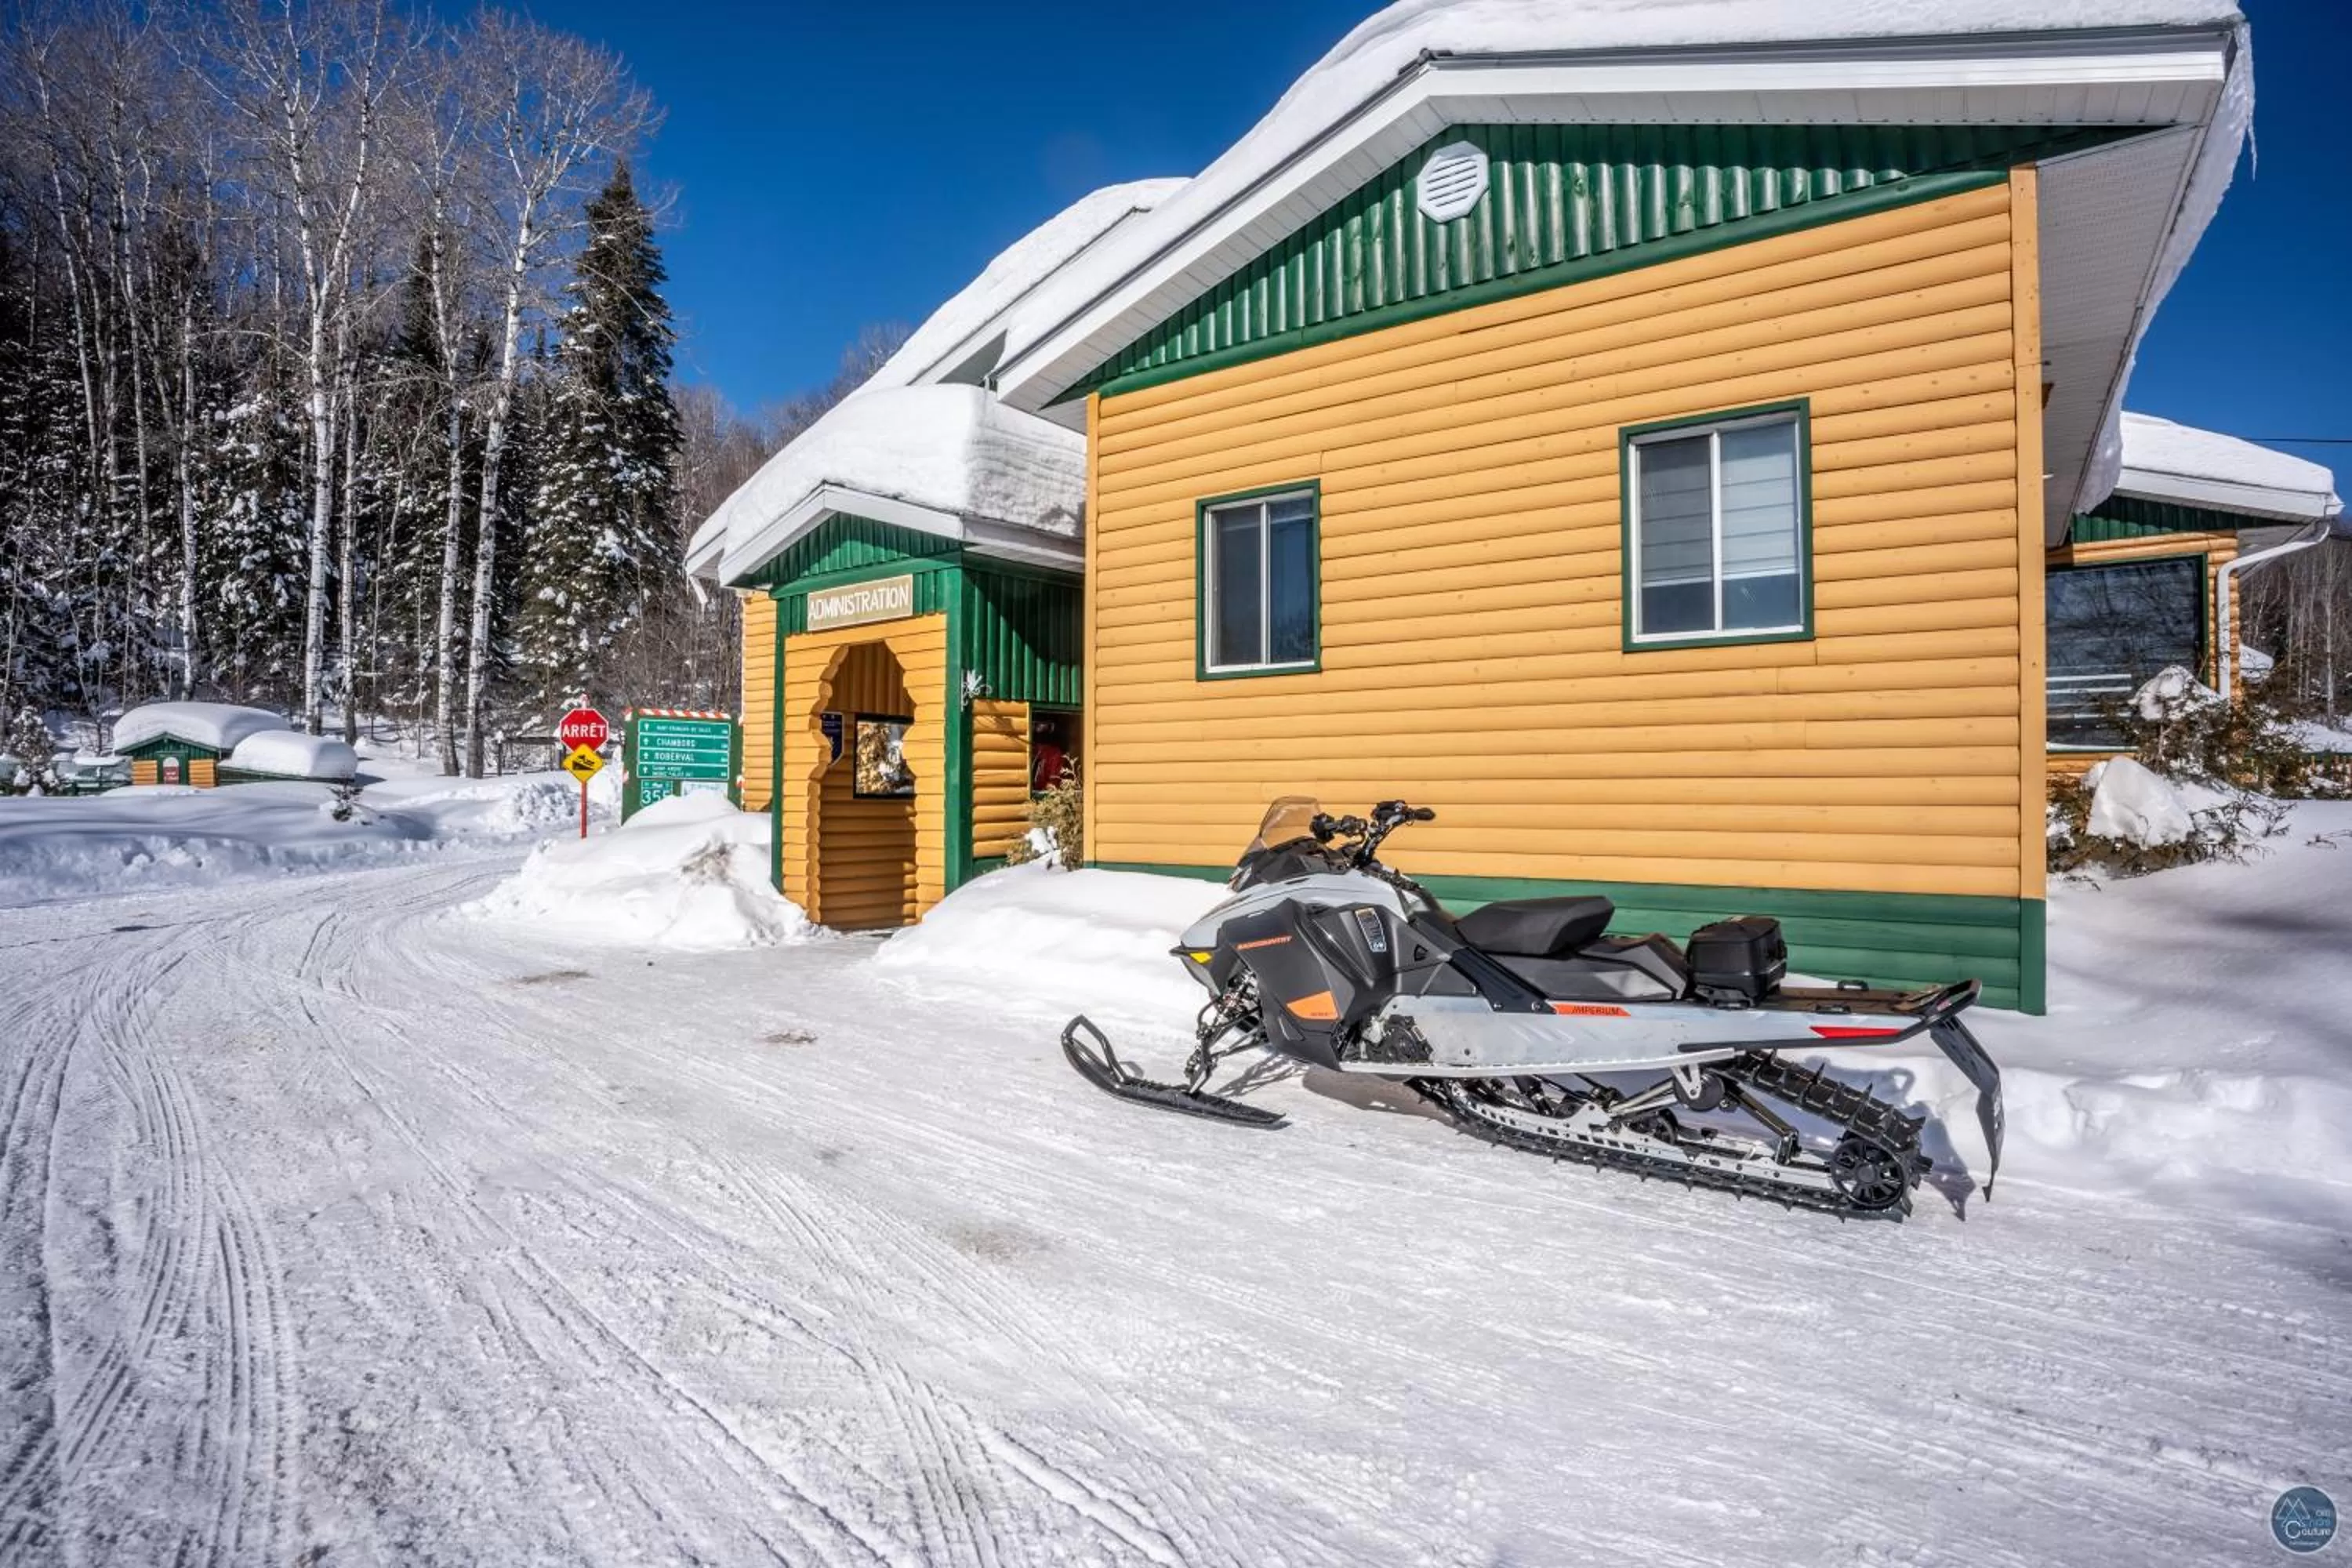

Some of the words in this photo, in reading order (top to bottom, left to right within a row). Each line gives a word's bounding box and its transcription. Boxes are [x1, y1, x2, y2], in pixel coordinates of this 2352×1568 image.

[808, 583, 909, 620] ADMINISTRATION
[562, 722, 606, 739] ARRÊT
[654, 752, 695, 762] ROBERVAL
